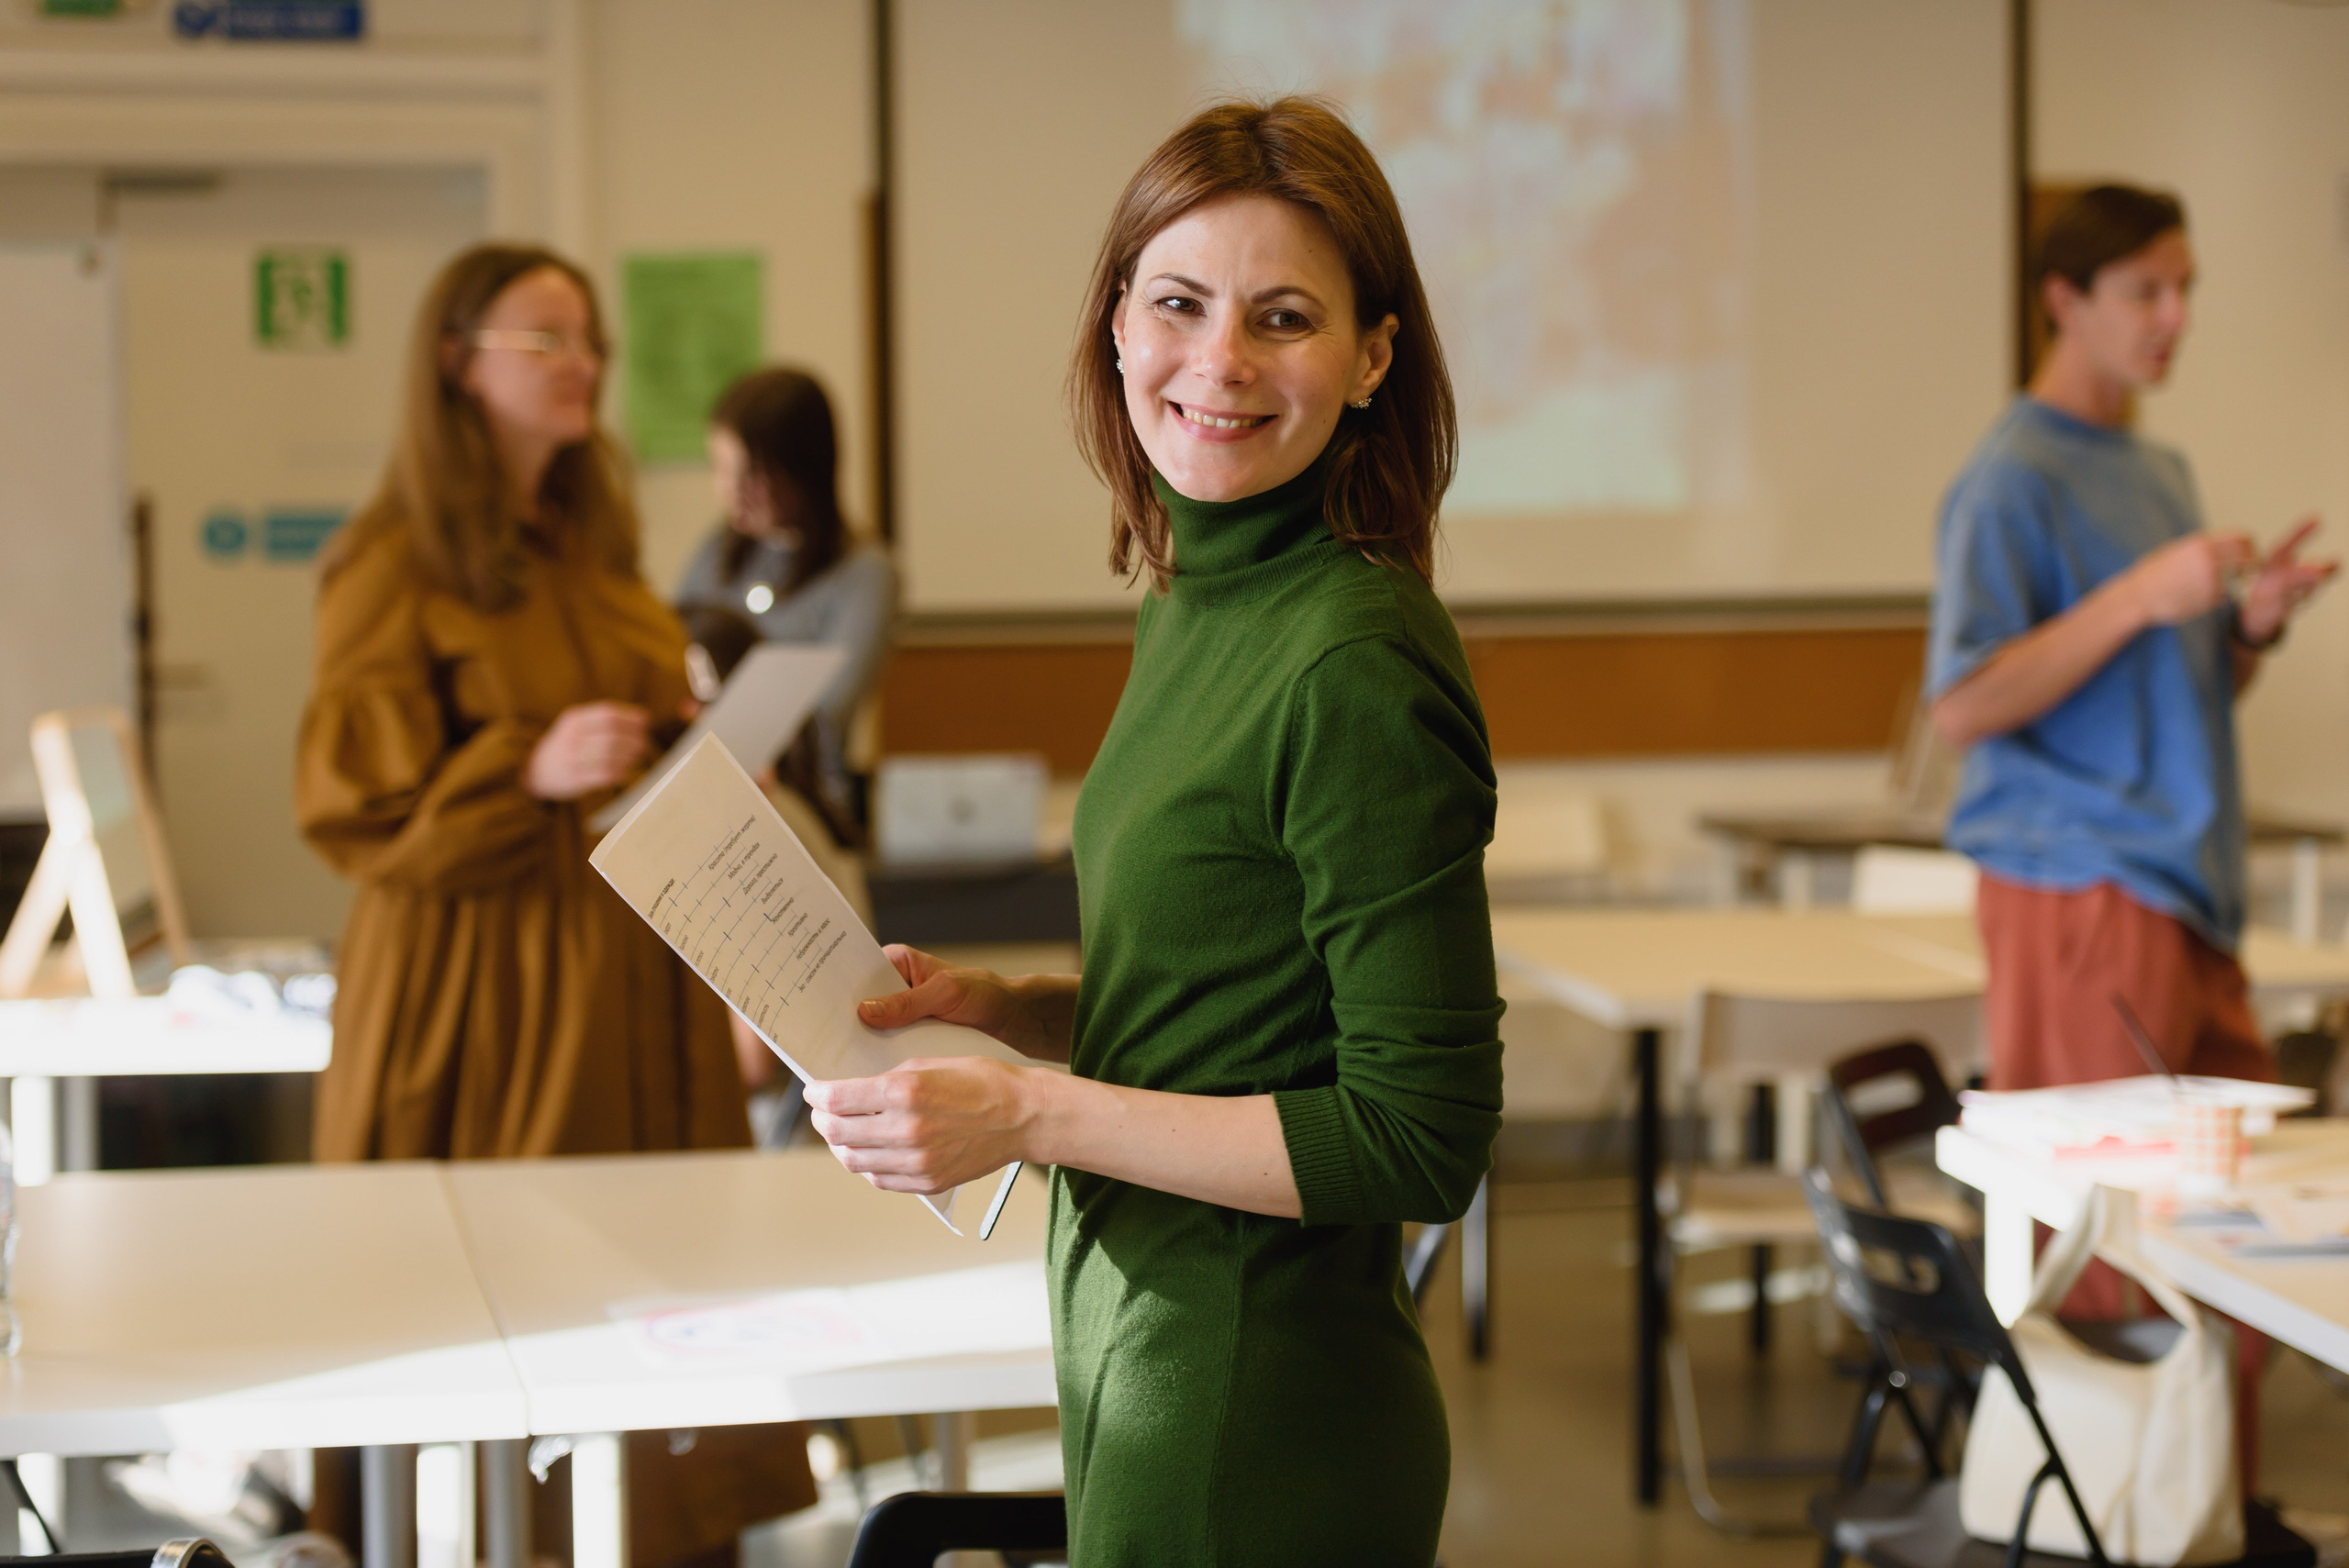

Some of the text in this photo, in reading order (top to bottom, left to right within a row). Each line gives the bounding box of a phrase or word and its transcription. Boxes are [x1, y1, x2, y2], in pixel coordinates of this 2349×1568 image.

[707, 851, 725, 871] Красота
[723, 831, 741, 853] (требует
[743, 842, 760, 862] трендах
[756, 853, 778, 878] престижно
[761, 877, 784, 905] Выделяться
[788, 912, 808, 937] Креативно
[796, 932, 818, 961] Небрежность
[820, 917, 830, 930] хаос
[818, 930, 847, 964] принципиально
